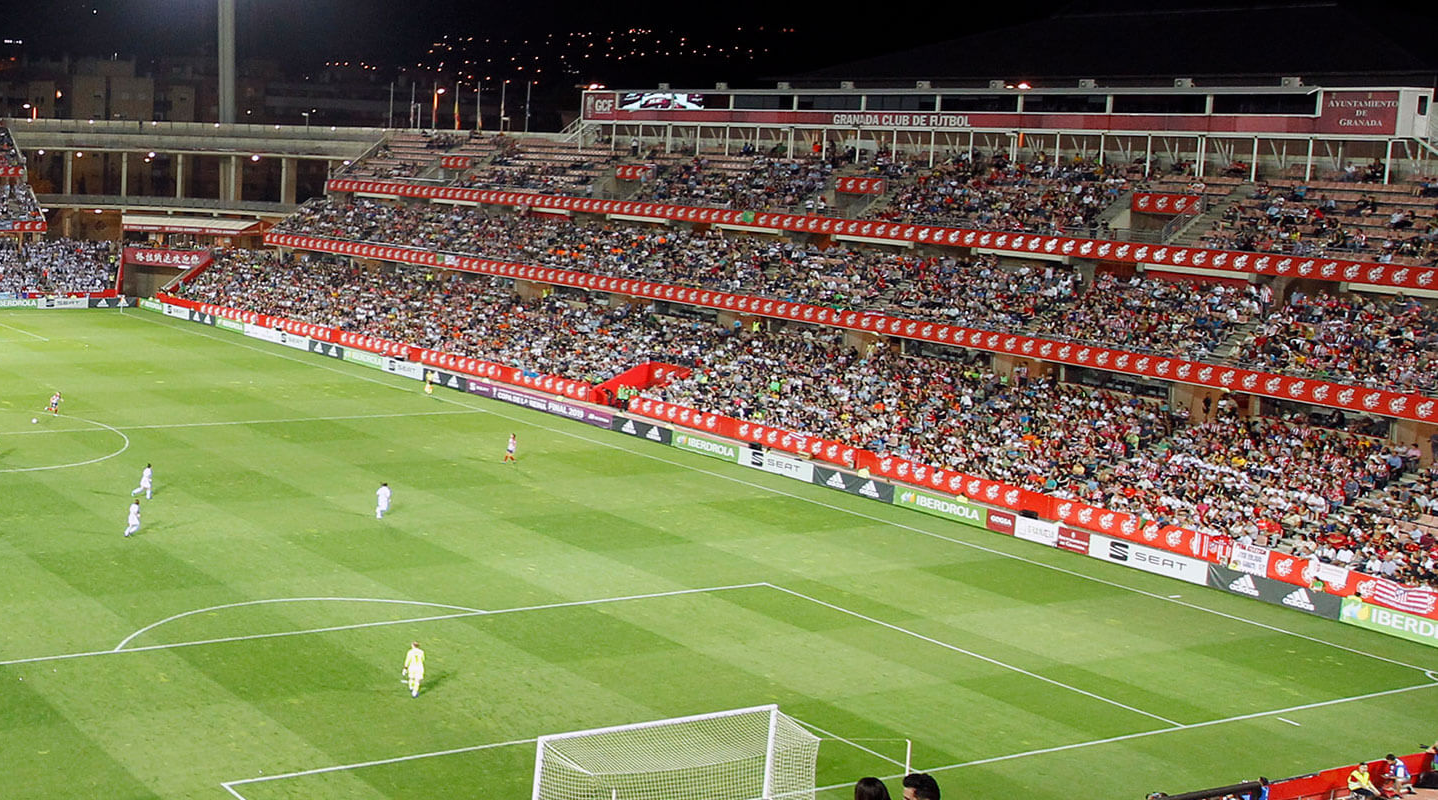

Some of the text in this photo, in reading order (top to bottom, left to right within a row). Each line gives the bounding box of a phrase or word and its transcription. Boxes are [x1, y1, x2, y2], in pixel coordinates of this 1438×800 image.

[595, 100, 613, 111] GCF
[833, 113, 971, 127] GRANADA CLUB DE FÚTBOL
[548, 401, 568, 414] FINAL
[688, 437, 735, 457] IBERDROLA
[767, 457, 800, 473] SEAT
[916, 495, 980, 520] IBERDROLA
[1135, 551, 1187, 571] SEAT
[1229, 583, 1259, 596] adidas
[1282, 597, 1315, 611] adidas
[1371, 607, 1438, 639] IBERD
